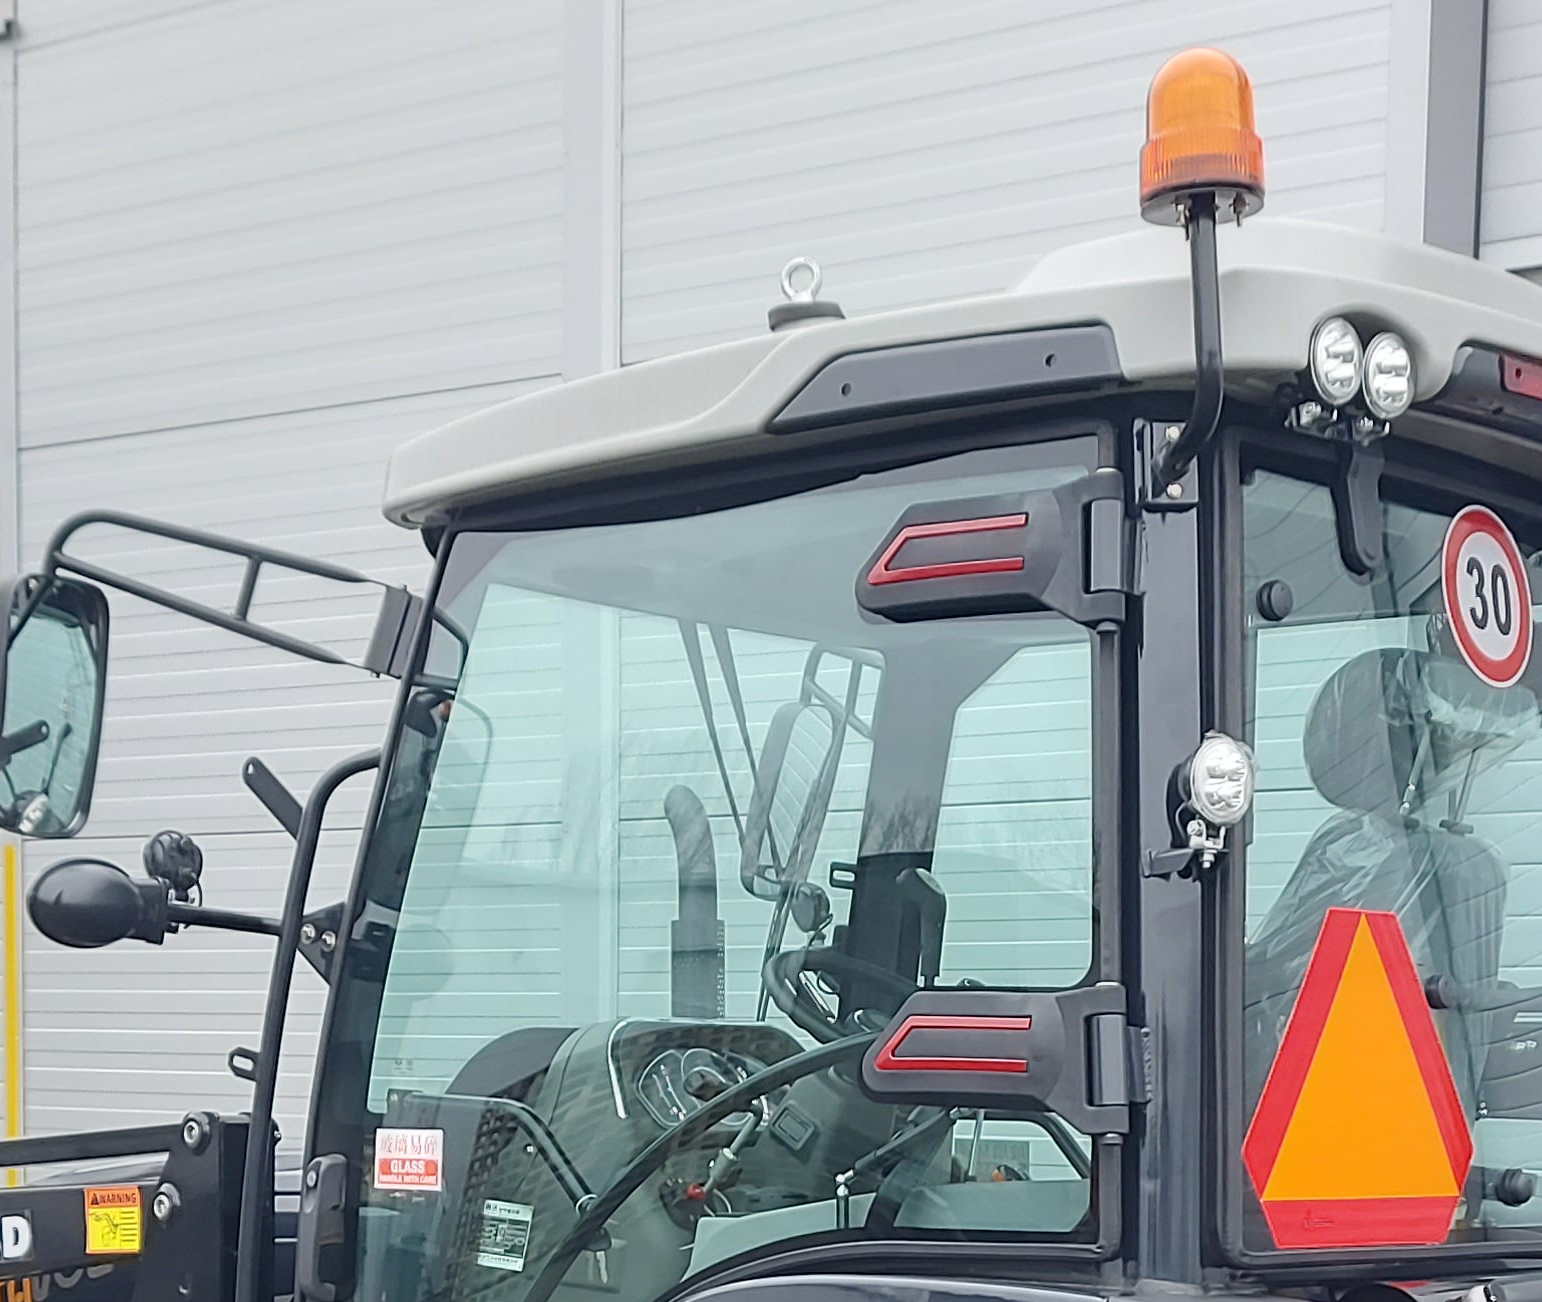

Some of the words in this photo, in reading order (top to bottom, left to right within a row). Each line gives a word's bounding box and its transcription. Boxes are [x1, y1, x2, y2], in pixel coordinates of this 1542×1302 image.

[1466, 556, 1512, 636] 30
[390, 1160, 425, 1173] GLASS
[99, 1193, 137, 1204] WARNING
